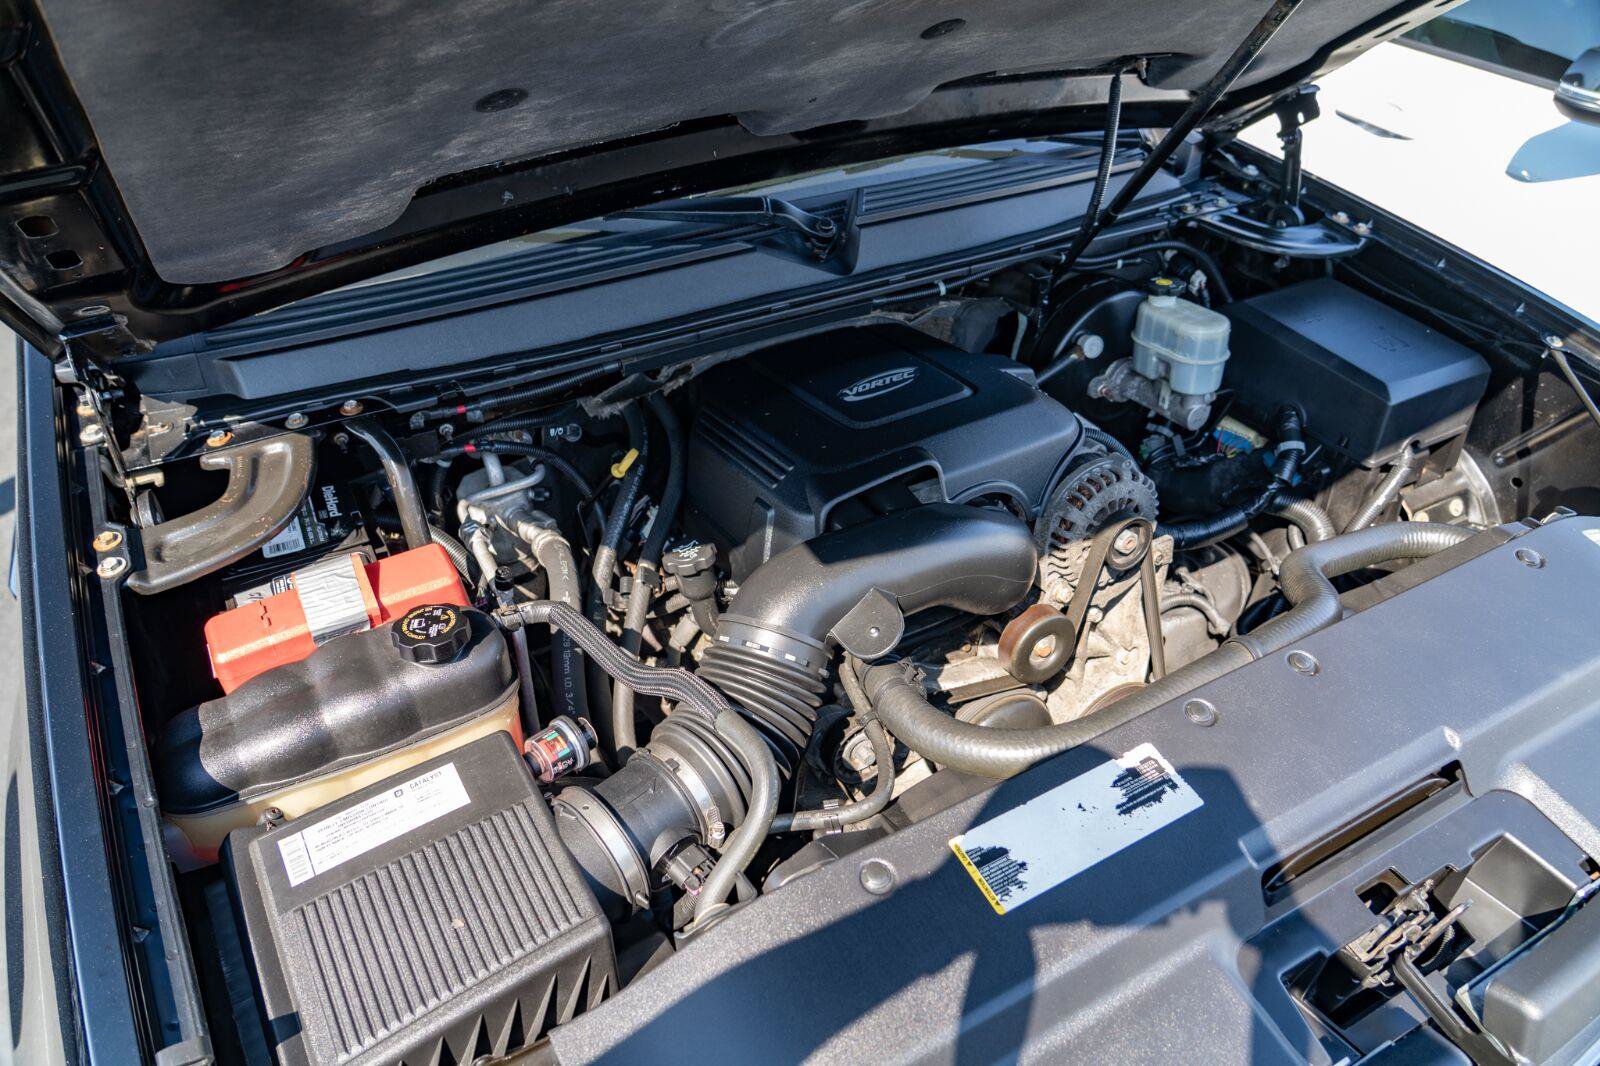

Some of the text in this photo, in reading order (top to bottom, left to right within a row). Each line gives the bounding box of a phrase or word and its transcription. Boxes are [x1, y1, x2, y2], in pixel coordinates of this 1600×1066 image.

[843, 369, 915, 395] VORTEC
[321, 484, 340, 518] DieHard
[409, 770, 443, 789] CATALYST
